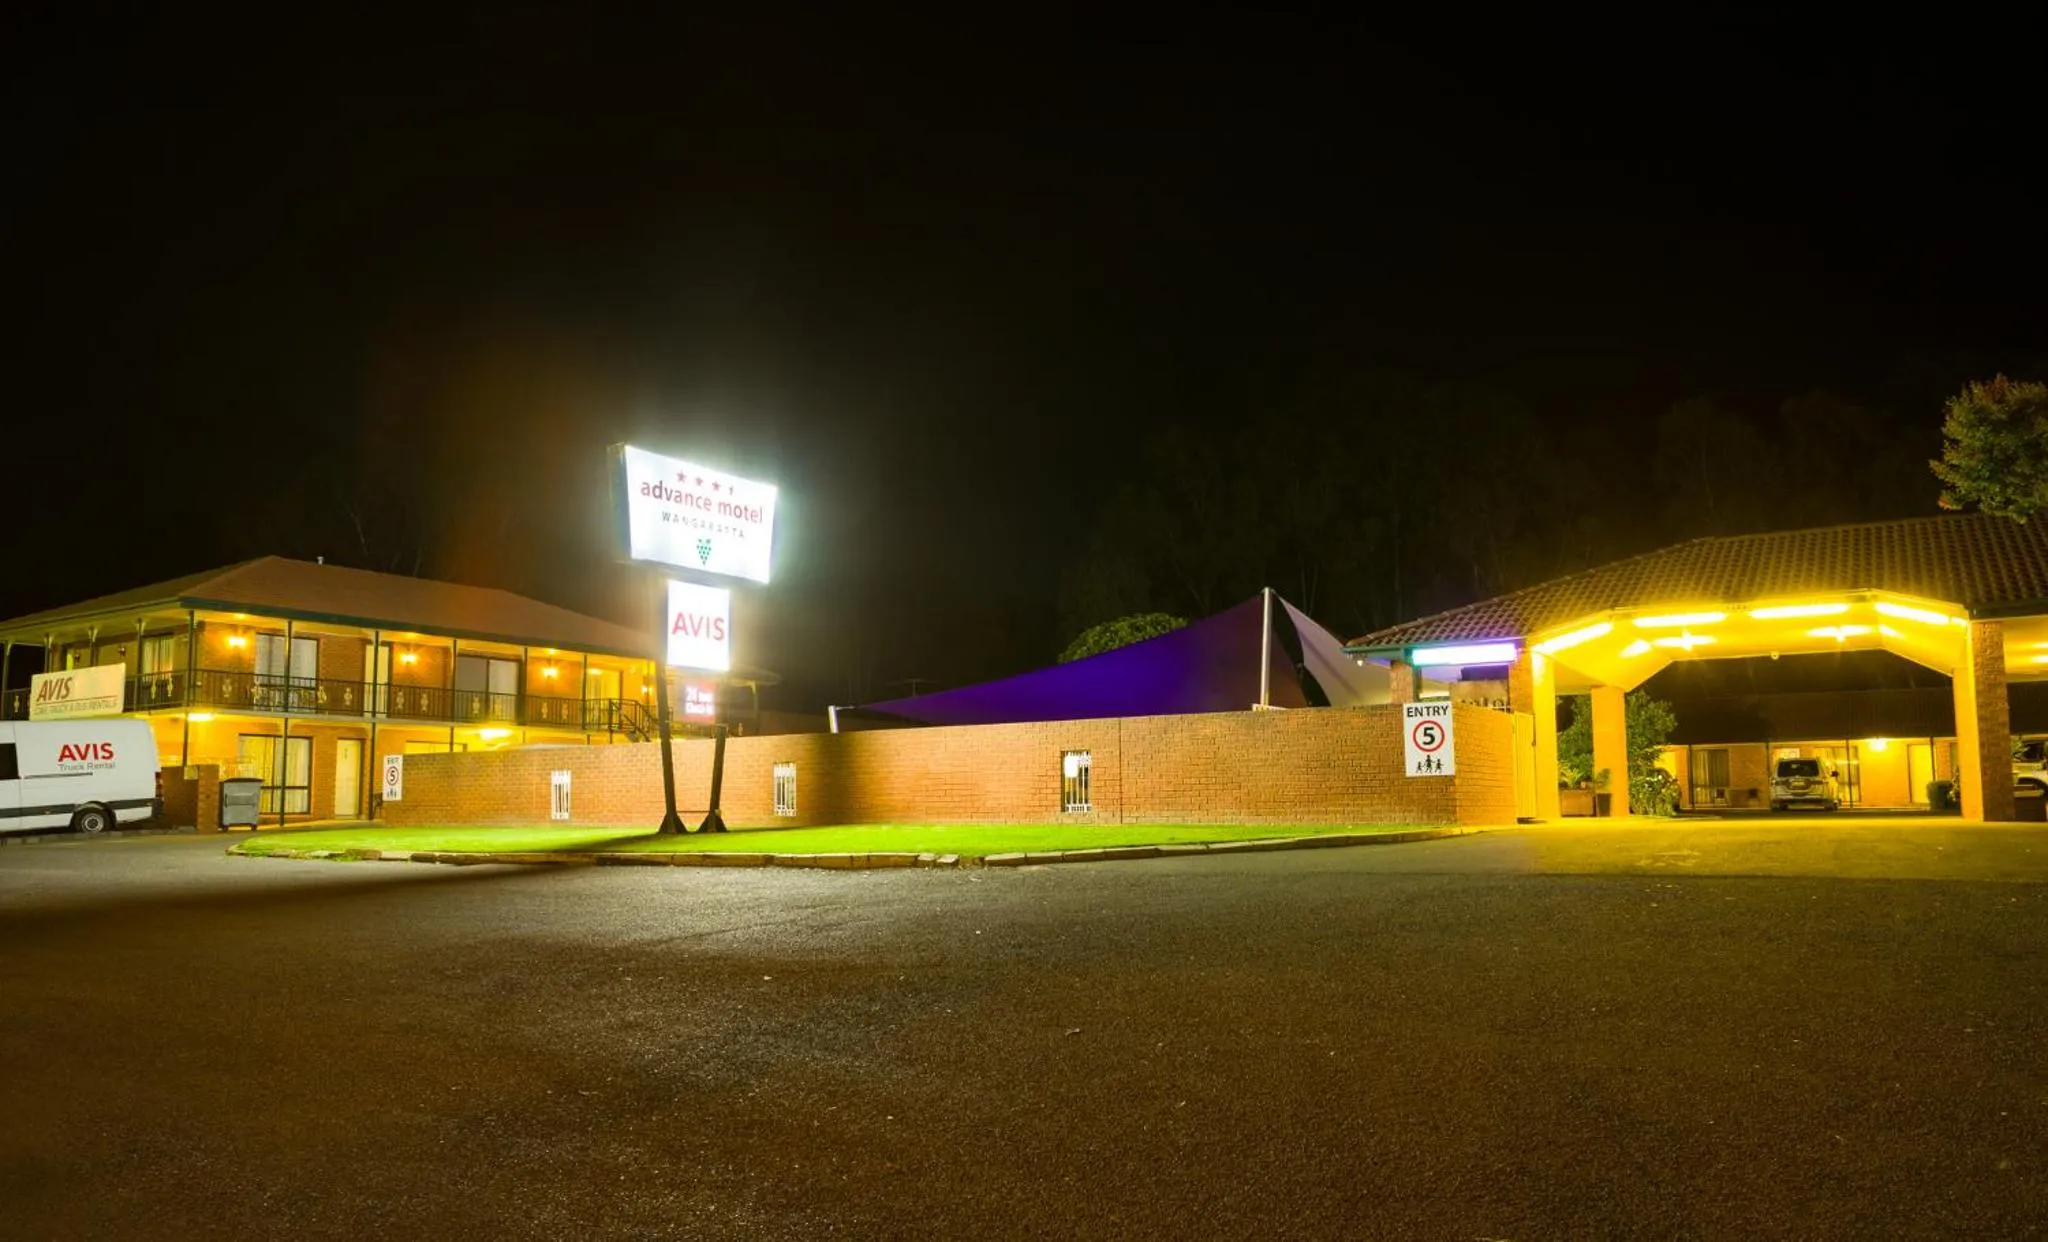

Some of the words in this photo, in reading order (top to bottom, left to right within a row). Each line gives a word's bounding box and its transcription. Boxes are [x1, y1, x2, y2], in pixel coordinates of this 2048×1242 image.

[640, 480, 713, 512] advance
[718, 502, 764, 524] motel
[671, 612, 725, 641] AVIS
[37, 677, 73, 702] AVIS
[1406, 705, 1449, 718] ENTRY
[1422, 726, 1436, 745] 5
[58, 742, 114, 762] AVIS
[58, 763, 84, 771] Truck
[87, 762, 116, 770] Rental
[390, 770, 396, 782] 5
